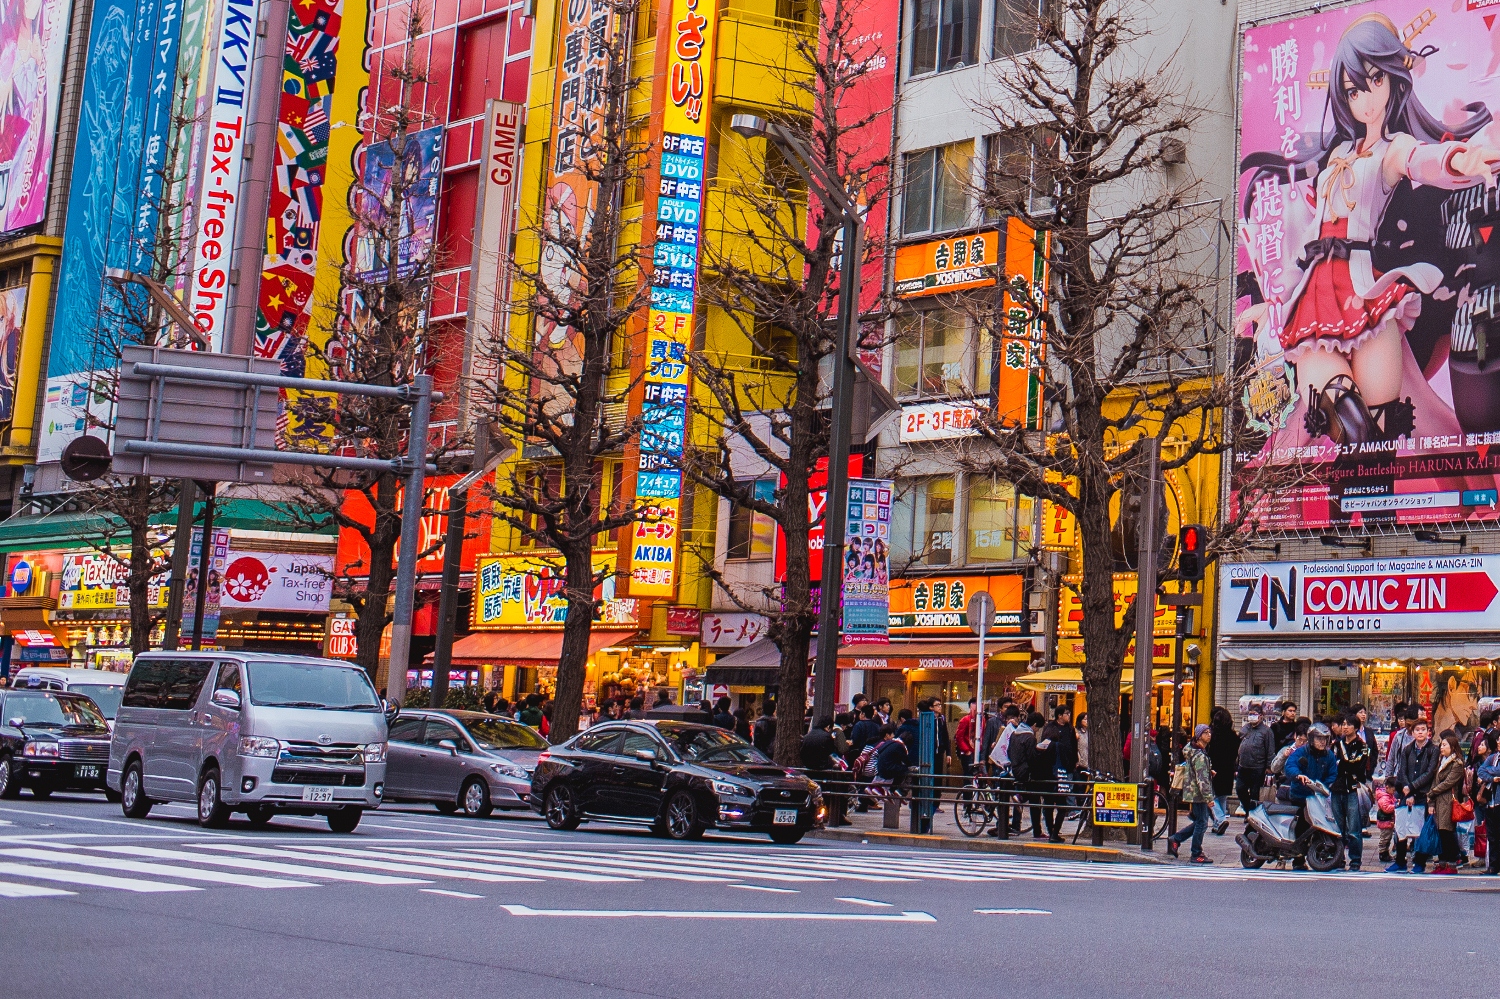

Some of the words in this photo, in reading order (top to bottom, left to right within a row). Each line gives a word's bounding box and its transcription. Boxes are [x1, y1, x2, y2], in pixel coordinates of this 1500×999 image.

[490, 111, 518, 188] GAME
[664, 163, 699, 179] DVD
[201, 115, 242, 261] Tax-free
[660, 205, 697, 223] DVD
[1359, 439, 1405, 454] AMAKUNI
[1357, 459, 1406, 481] Battleship
[1408, 457, 1462, 475] HARUNA
[633, 545, 673, 563] AKIBA
[1230, 566, 1260, 579] COMIC
[1303, 563, 1345, 573] Professional
[1346, 562, 1375, 574] Support
[1376, 561, 1387, 571] for
[1388, 560, 1426, 572] Magazine
[1427, 560, 1434, 570] &
[1435, 557, 1484, 570] MANGA-ZIN
[281, 576, 327, 590] Tax-free
[295, 589, 325, 604] Shop
[914, 579, 966, 611] 吉野家
[1306, 579, 1400, 612] COMIC
[1405, 577, 1447, 610] ZIN
[914, 613, 961, 626] YOSHINOYA
[1302, 616, 1382, 631] Akihabara
[854, 658, 888, 668] YOSHINOYA
[918, 658, 954, 668] YOSHINOYA
[310, 792, 332, 802] 12-97
